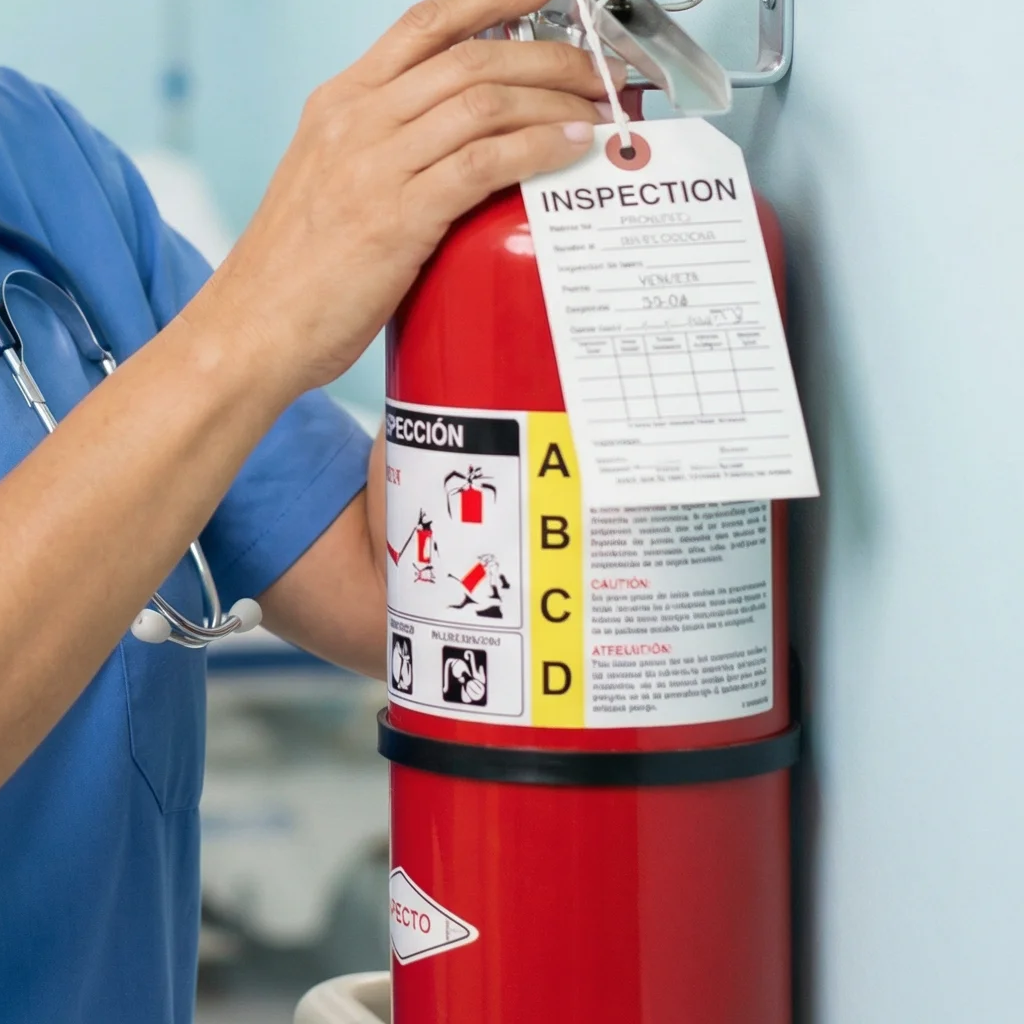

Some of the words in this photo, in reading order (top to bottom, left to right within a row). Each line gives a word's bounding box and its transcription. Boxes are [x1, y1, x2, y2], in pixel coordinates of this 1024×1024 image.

[541, 177, 738, 212] INSPECTION
[538, 442, 571, 477] A
[541, 515, 571, 550] B
[540, 588, 571, 623] C
[542, 661, 572, 696] D
